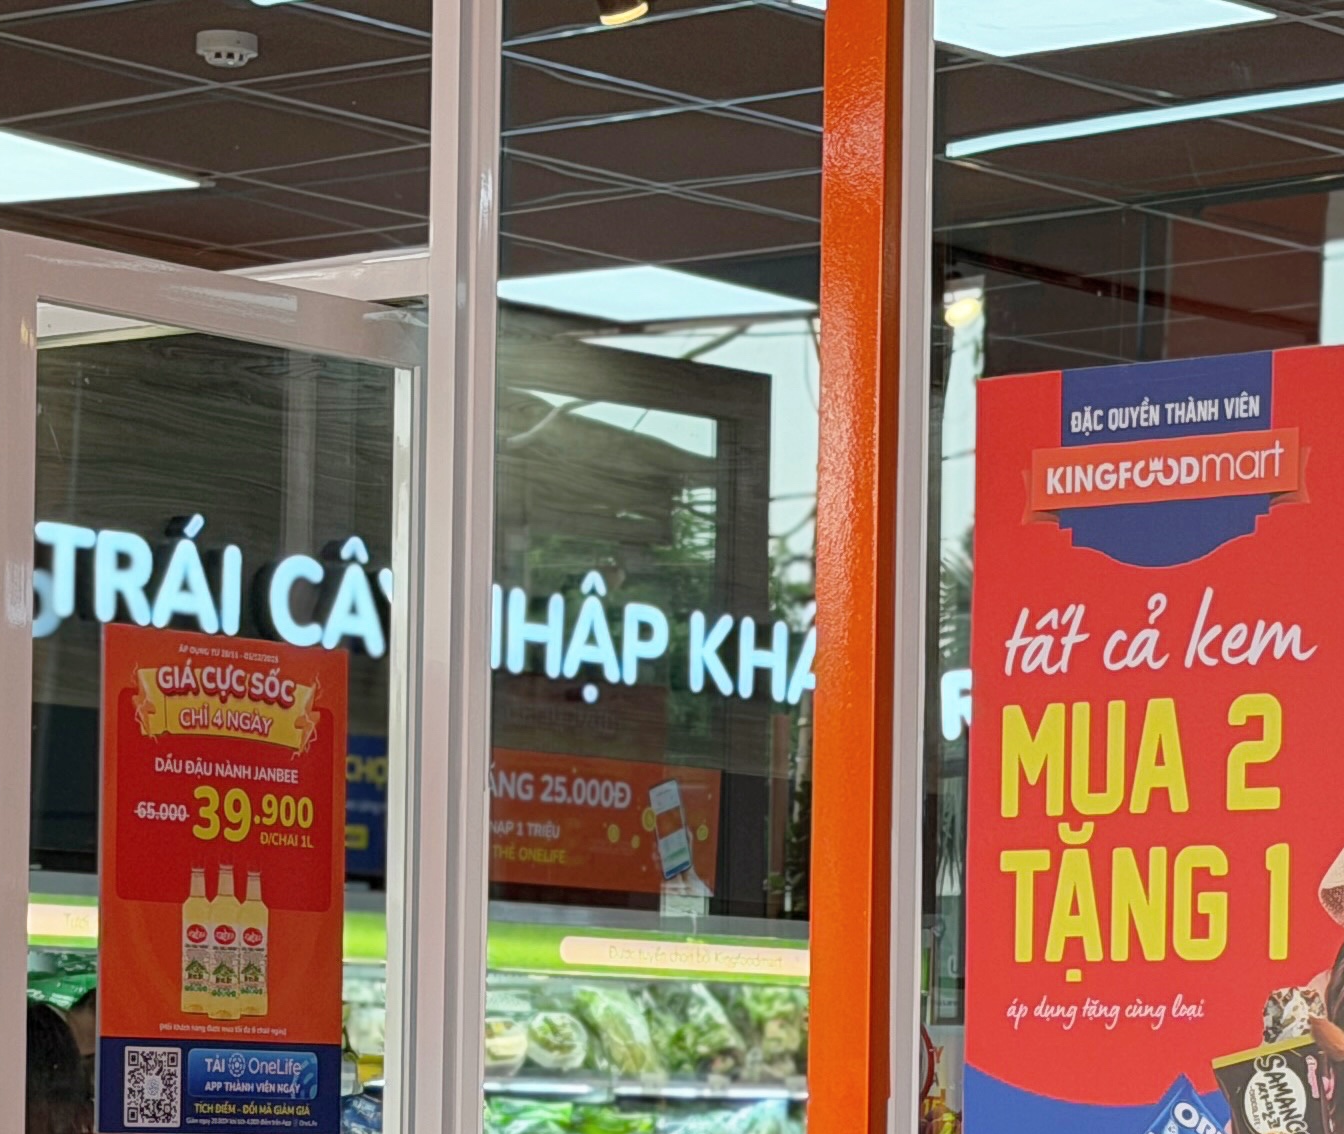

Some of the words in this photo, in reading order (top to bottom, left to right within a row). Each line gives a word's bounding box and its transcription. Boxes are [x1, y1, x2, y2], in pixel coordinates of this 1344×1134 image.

[1070, 407, 1104, 434] ĐẶC
[1108, 397, 1160, 430] QUYỀN
[1165, 398, 1220, 425] THÀNH
[1224, 391, 1260, 421] VIÊN
[1047, 440, 1285, 495] KINGFOODmart
[34, 513, 243, 637] TRÁI
[1004, 604, 1090, 676] tất
[1103, 592, 1168, 670] cả
[1184, 587, 1317, 668] kem
[158, 657, 197, 690] GIÁ
[202, 664, 246, 697] CỰC
[250, 668, 295, 703] SỐC
[215, 763, 252, 780] NÀNH
[253, 768, 299, 784] JANBEE
[1001, 698, 1189, 817] MUA
[1226, 693, 1282, 811] 2
[192, 785, 314, 842] 39.900
[1000, 822, 1228, 982] TẶNG
[1265, 842, 1290, 960] 1
[1006, 998, 1029, 1029] áp
[1033, 996, 1077, 1030] dụng
[1081, 998, 1120, 1030] tặng
[1125, 999, 1166, 1030] cùng
[1171, 993, 1205, 1018] loại
[248, 1057, 302, 1076] OneLife
